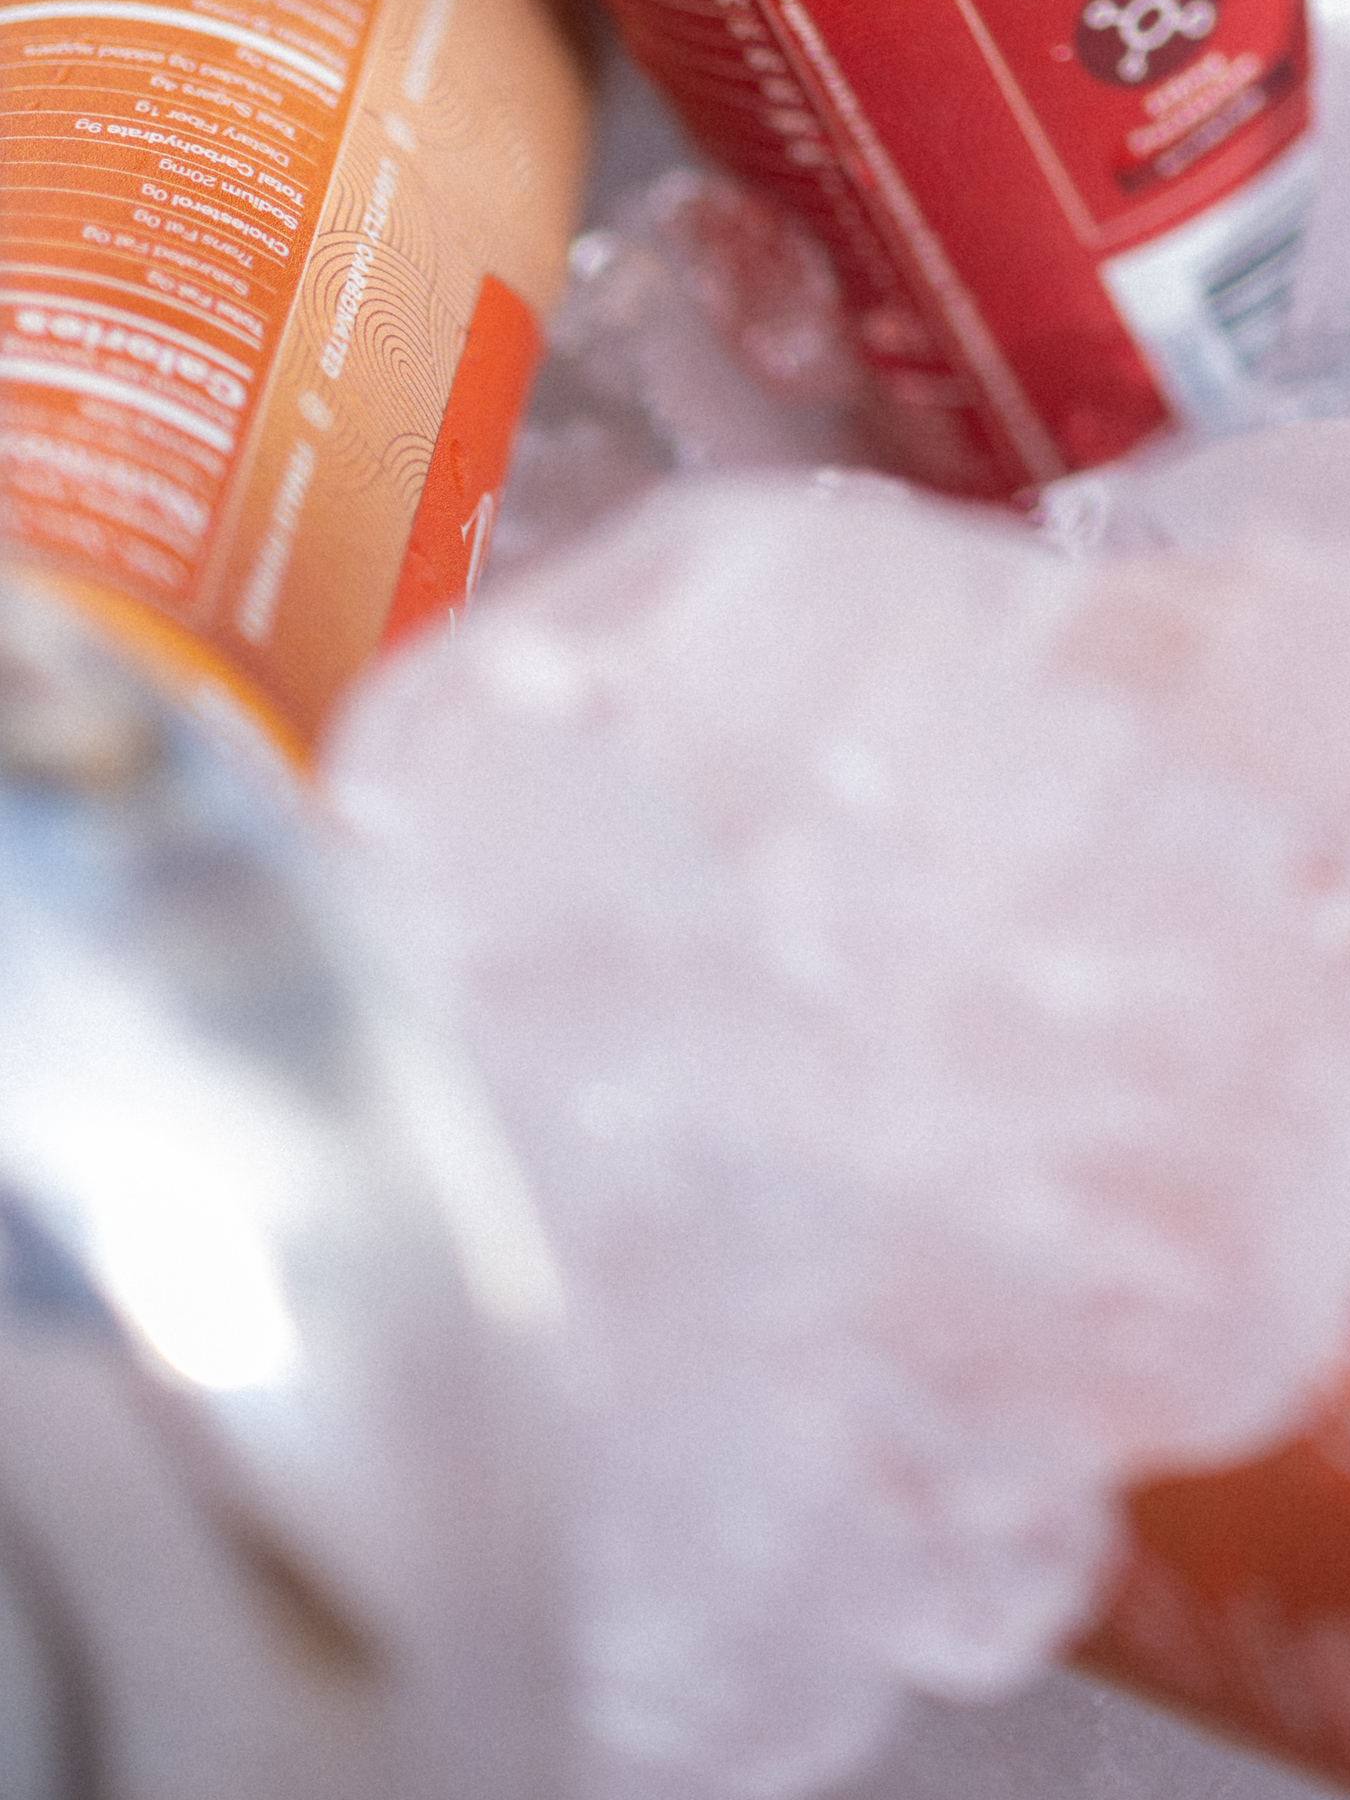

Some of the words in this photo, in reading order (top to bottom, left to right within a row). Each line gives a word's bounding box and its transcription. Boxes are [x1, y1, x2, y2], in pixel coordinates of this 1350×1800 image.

[97, 46, 166, 65] added
[167, 53, 197, 73] 0g
[149, 72, 180, 93] 4g
[198, 62, 284, 106] Included
[134, 99, 161, 118] 1g
[181, 81, 253, 119] Sugars
[74, 117, 102, 135] 9g
[165, 107, 220, 136] Fiber
[255, 109, 298, 142] Total
[106, 123, 256, 180] Carbohydrate
[222, 125, 292, 169] Dietary
[157, 157, 218, 190] 20mg
[256, 170, 306, 209] Total
[141, 182, 169, 204] 0g
[219, 180, 299, 232] Sodium
[362, 156, 400, 249] LIGHTLY
[81, 223, 111, 245] 0g
[132, 207, 161, 229] 0g
[165, 219, 199, 243] Fat
[170, 193, 291, 259] Cholesterol
[113, 232, 151, 256] Fat
[200, 233, 255, 270] Trans
[152, 242, 250, 298] Saturated
[176, 282, 213, 309] Fat
[318, 240, 375, 382] CARBONATED
[13, 302, 248, 411] Calories
